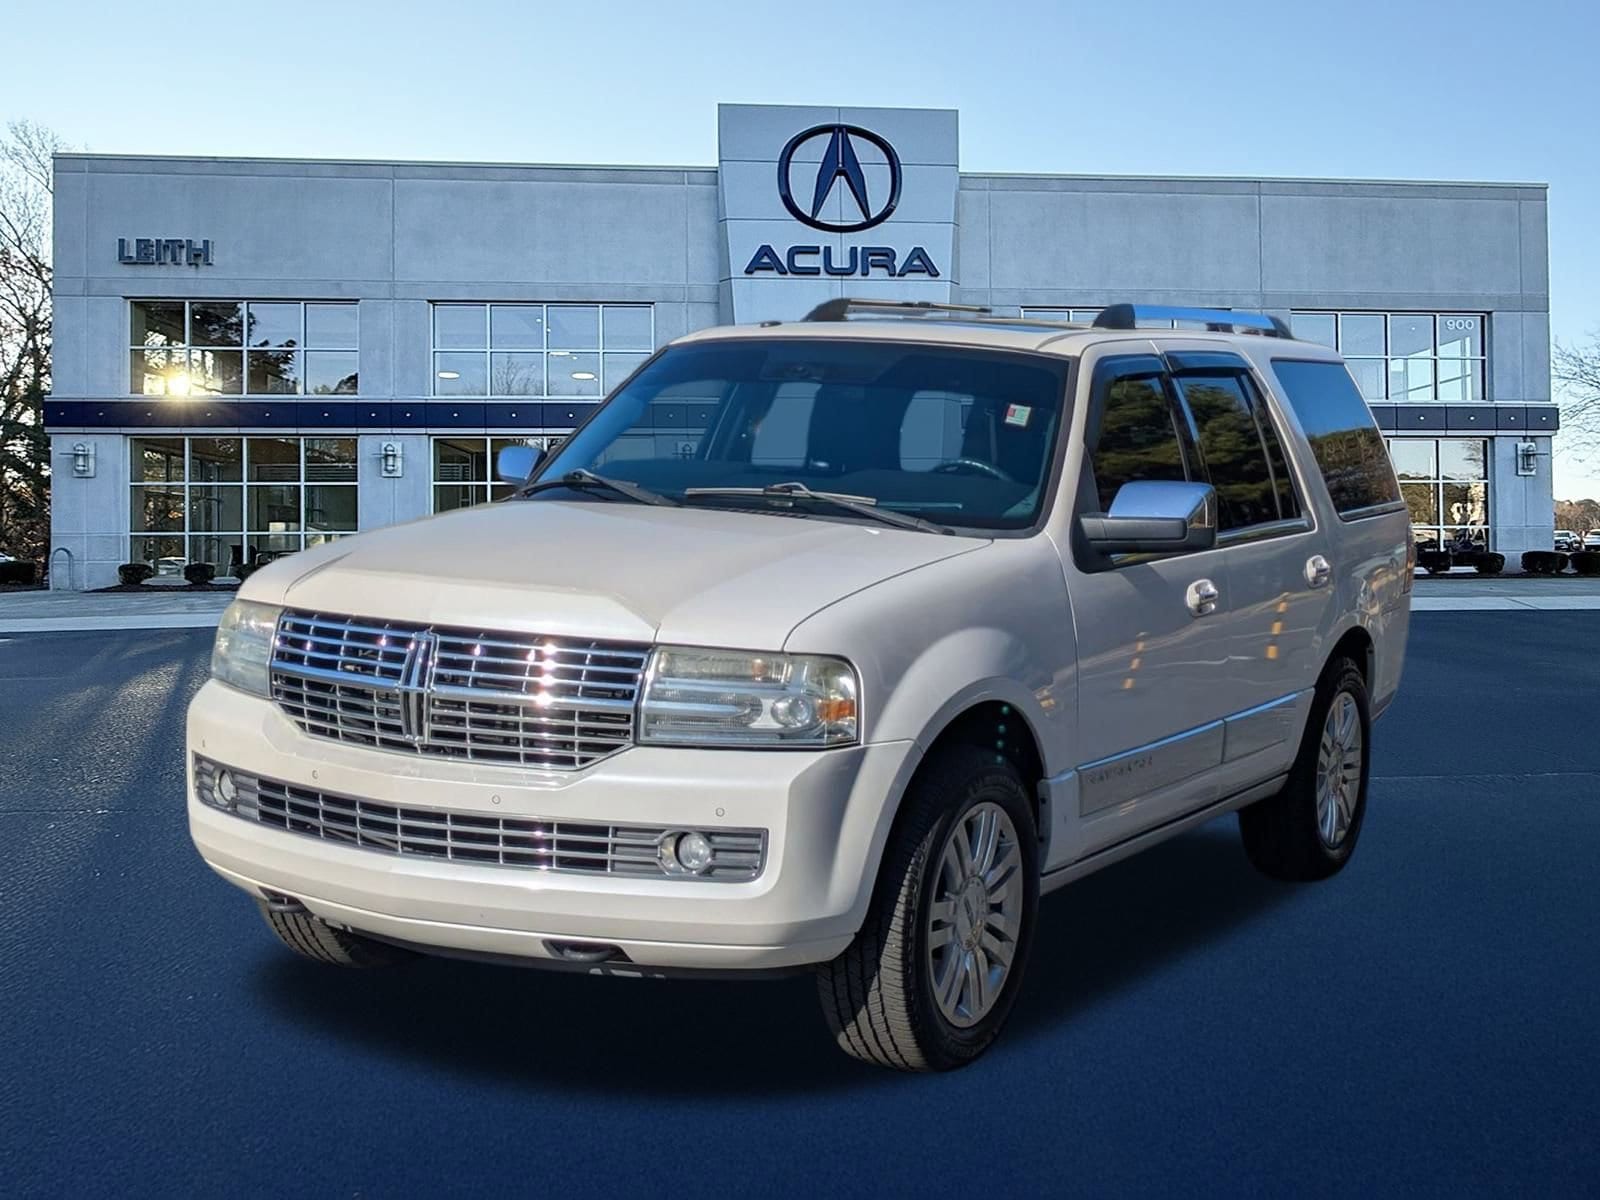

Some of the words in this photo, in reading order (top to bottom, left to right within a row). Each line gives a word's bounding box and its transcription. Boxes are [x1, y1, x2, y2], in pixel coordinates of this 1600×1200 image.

[118, 238, 211, 264] LEITH
[744, 244, 941, 277] ACURA
[1446, 319, 1474, 330] 900
